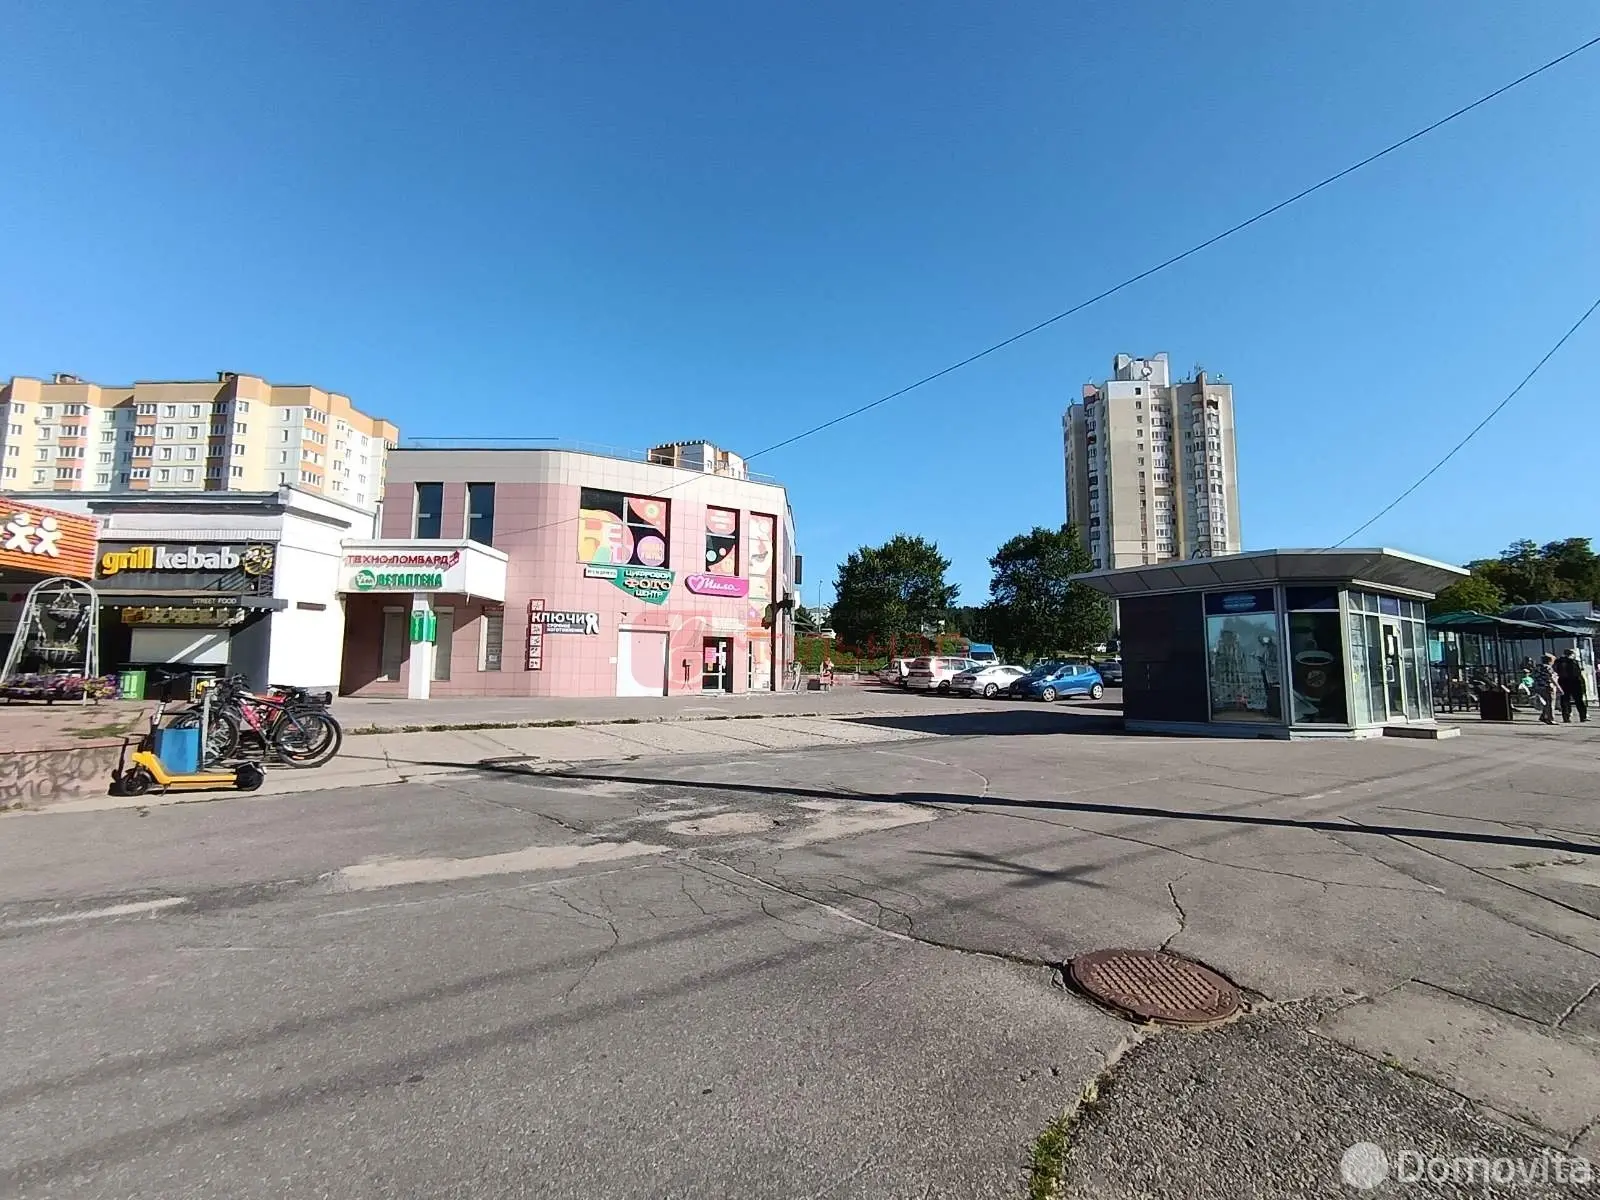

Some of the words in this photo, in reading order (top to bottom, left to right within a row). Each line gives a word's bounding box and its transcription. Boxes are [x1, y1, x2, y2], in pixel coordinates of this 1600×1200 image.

[102, 545, 154, 574] grill
[155, 546, 240, 569] kebab
[376, 573, 442, 587] ВЕТАПТЕКА
[624, 578, 672, 590] ФОТО
[635, 589, 663, 599] ЦЕНТР
[531, 611, 585, 624] КЛЮЧИ
